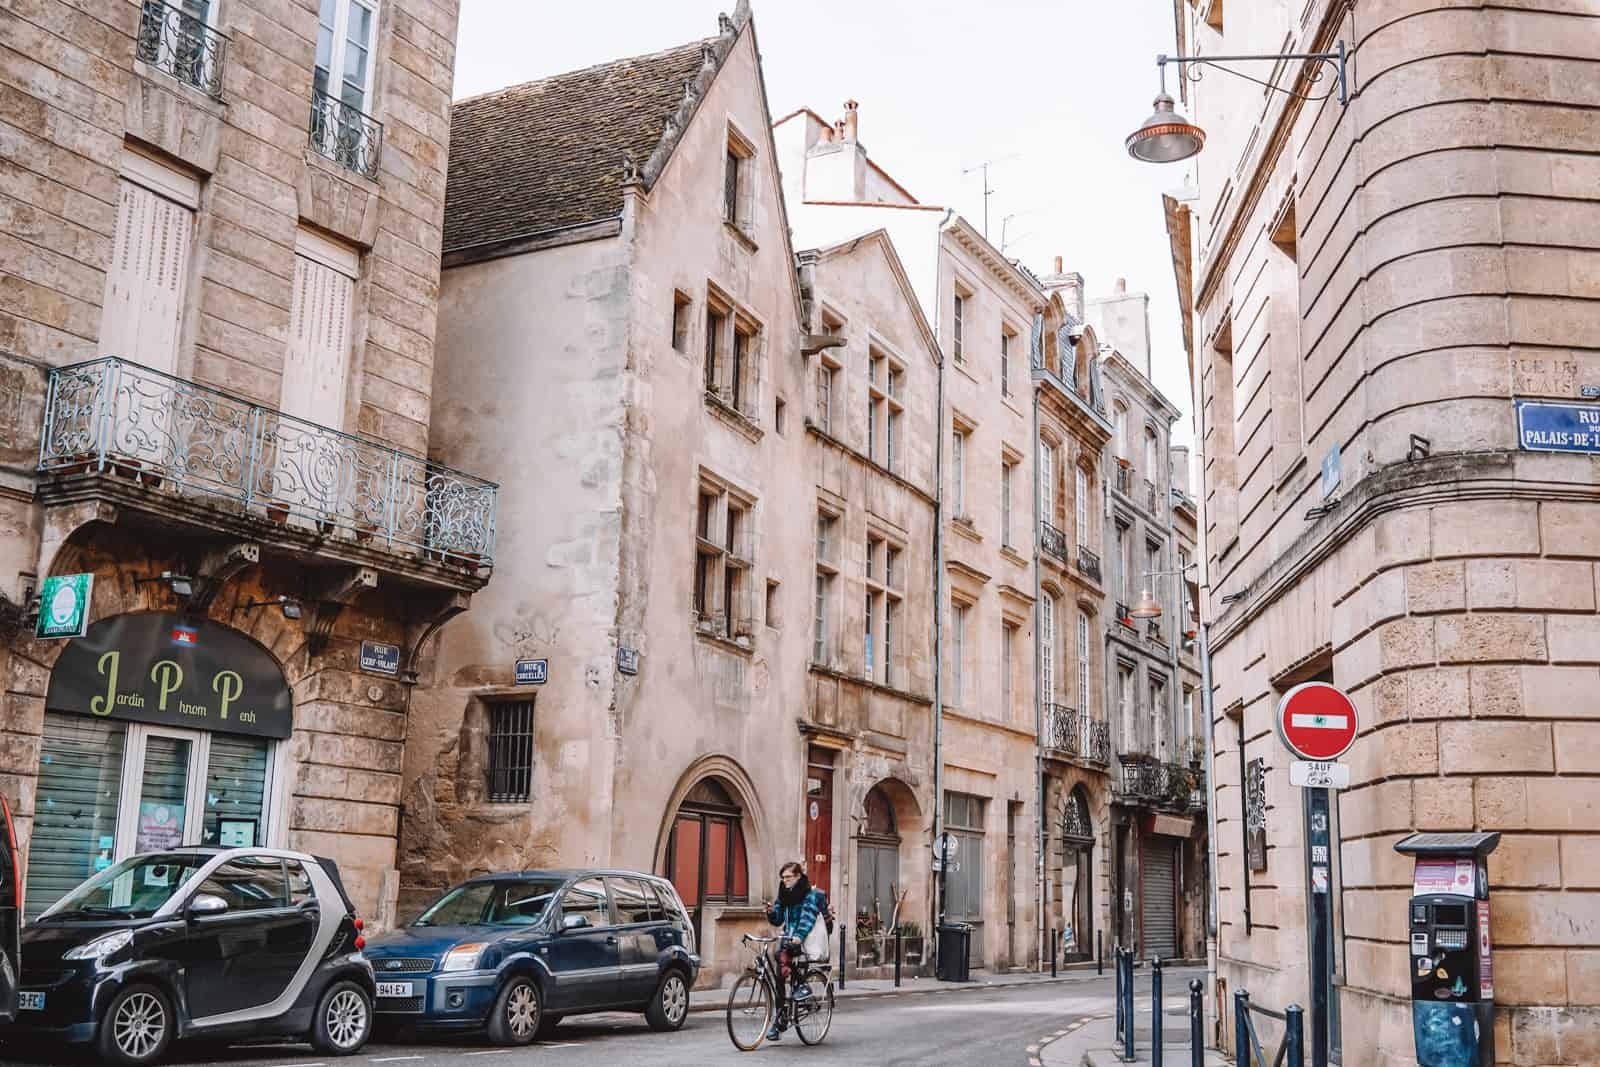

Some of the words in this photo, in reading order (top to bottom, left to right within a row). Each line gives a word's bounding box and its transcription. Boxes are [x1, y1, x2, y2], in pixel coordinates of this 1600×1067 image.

[374, 645, 388, 655] RUE
[524, 663, 538, 671] RUE
[90, 651, 145, 716] Jardin
[151, 660, 207, 717] Phnom
[212, 670, 256, 724] Penh
[1308, 762, 1331, 771] SAUF
